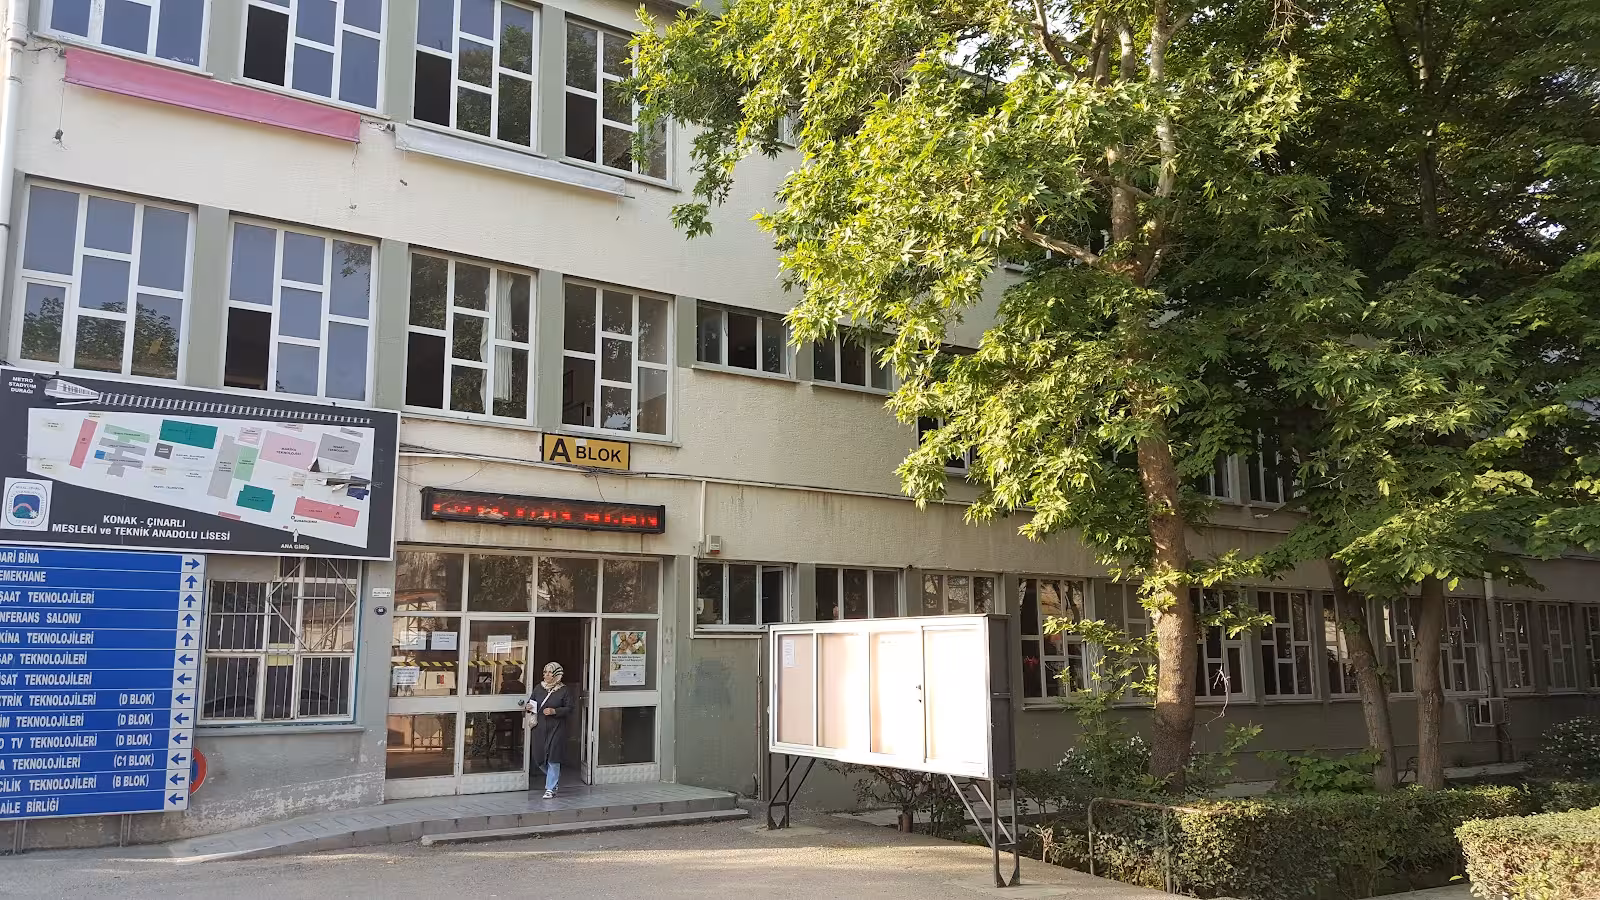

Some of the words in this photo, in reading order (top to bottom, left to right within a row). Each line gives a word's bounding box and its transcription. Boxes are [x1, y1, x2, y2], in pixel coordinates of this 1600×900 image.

[549, 438, 572, 463] A
[575, 445, 622, 463] BLOK
[103, 515, 138, 525] KONAK
[147, 517, 186, 528] ÇINARLI
[52, 523, 97, 534] MESLEKİ
[100, 527, 111, 535] ve
[115, 526, 150, 537] TEKNİK
[152, 529, 198, 540] ANADOLU
[200, 530, 230, 541] LİSESİ
[293, 543, 310, 551] GİRİŞ
[0, 550, 16, 563] ARİ
[18, 550, 40, 564] BİNA
[28, 590, 94, 604] TEKNOLOJİLERİ
[46, 612, 81, 625] SALONU
[27, 631, 94, 645] TEKNOLOJİLERİ
[0, 653, 13, 665] AP
[20, 651, 87, 665] TEKNOLOJİLERİ
[25, 671, 92, 686] TEKNOLOJİLERİ
[0, 693, 23, 707] TRİK
[29, 692, 96, 707] TEKNOLOJİLERİ
[119, 693, 128, 706] (D
[129, 692, 155, 706] BLOK)
[16, 713, 84, 728] TEKNOLOJİLERİ
[117, 714, 126, 727] (D
[128, 713, 153, 727] BLOK)
[11, 737, 23, 749] TV
[30, 733, 97, 749] TEKNOLOJİLERİ
[116, 734, 124, 747] (D
[126, 733, 152, 747] BLOK)
[13, 754, 80, 770] TEKNOLOJİLERİ
[114, 755, 126, 768] (C1
[129, 754, 154, 768] BLOK)
[29, 776, 96, 791] TEKNOLOJİLERİ
[113, 776, 122, 789] (B
[123, 775, 149, 788] BLOK)
[0, 800, 20, 814] AİLE
[26, 797, 59, 813] BİRLİĞİ
